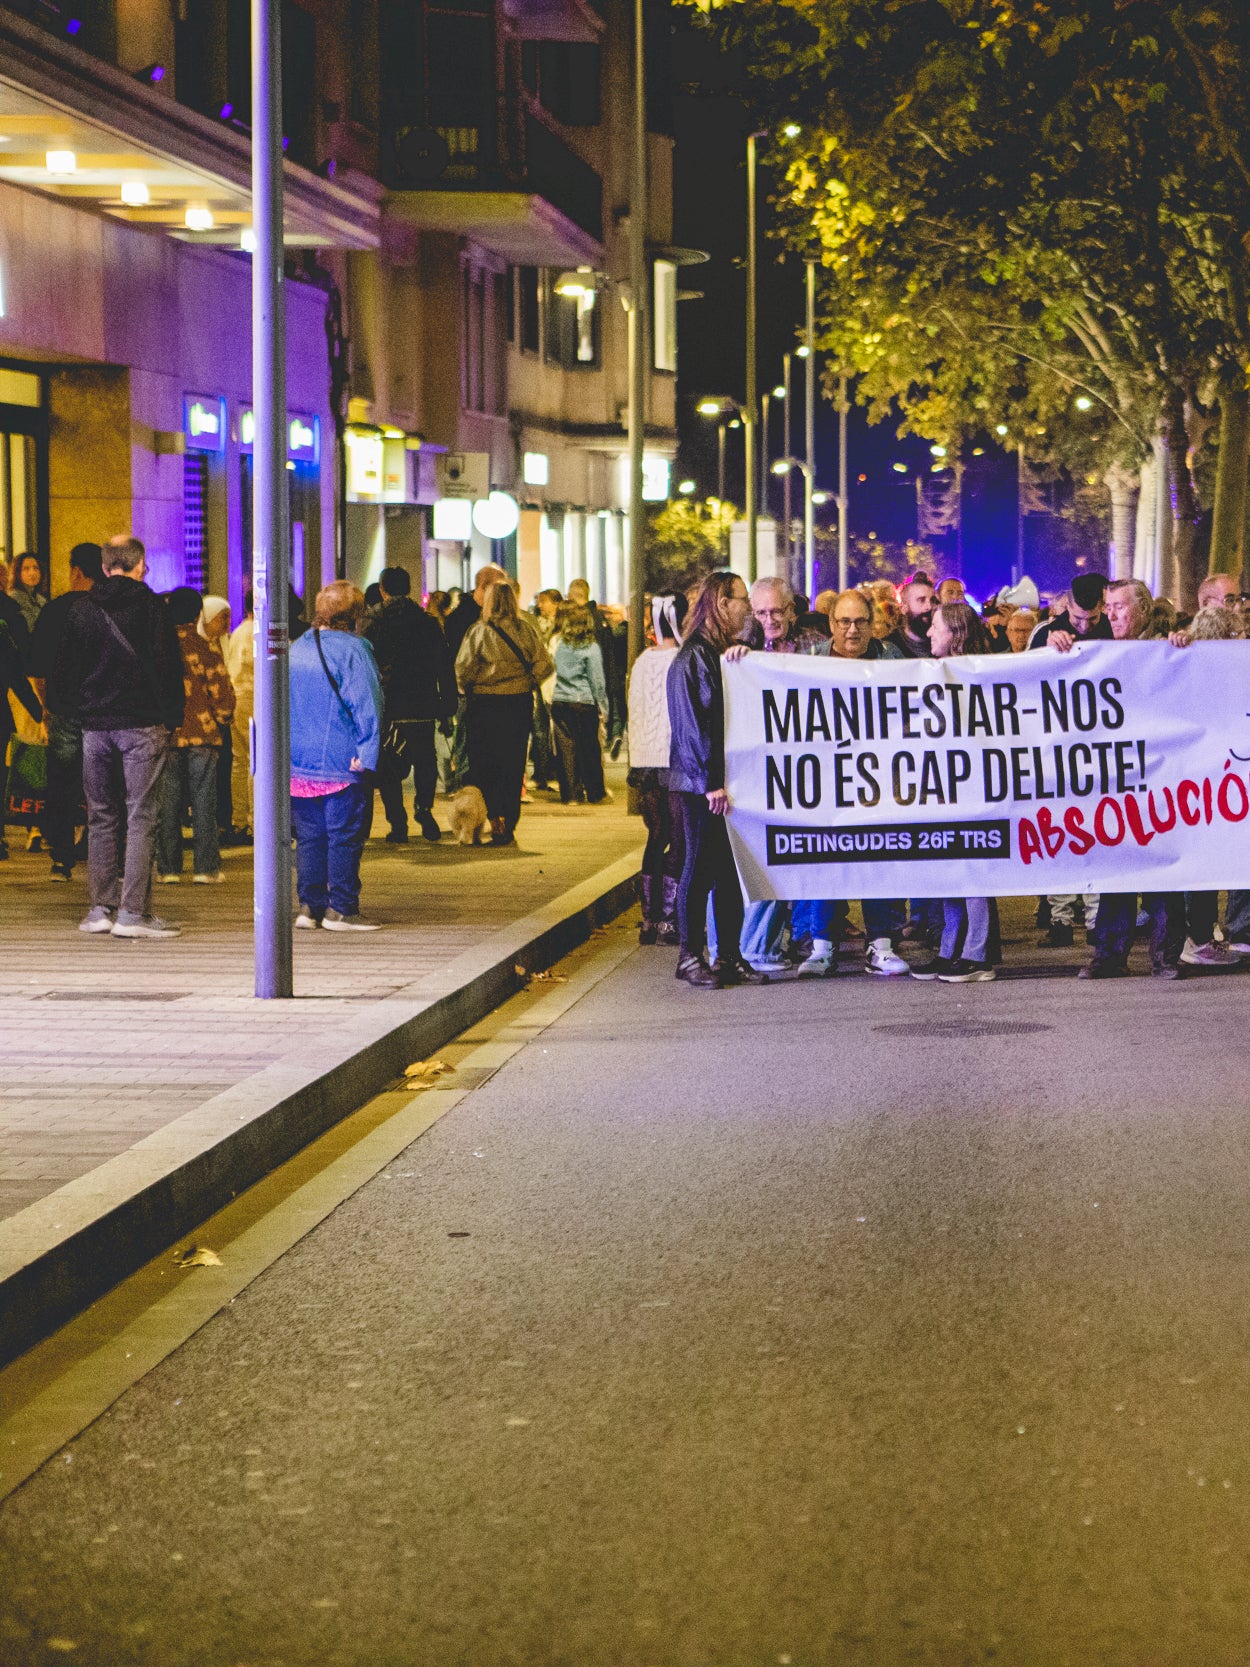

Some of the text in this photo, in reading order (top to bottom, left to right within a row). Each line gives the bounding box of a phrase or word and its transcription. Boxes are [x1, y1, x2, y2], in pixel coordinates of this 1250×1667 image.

[762, 677, 1125, 744] MANIFESTAR-NOS
[765, 738, 1148, 811] NO ÉS CAP DELICTE!
[774, 828, 1003, 855] DETINGUDES 26F TRS
